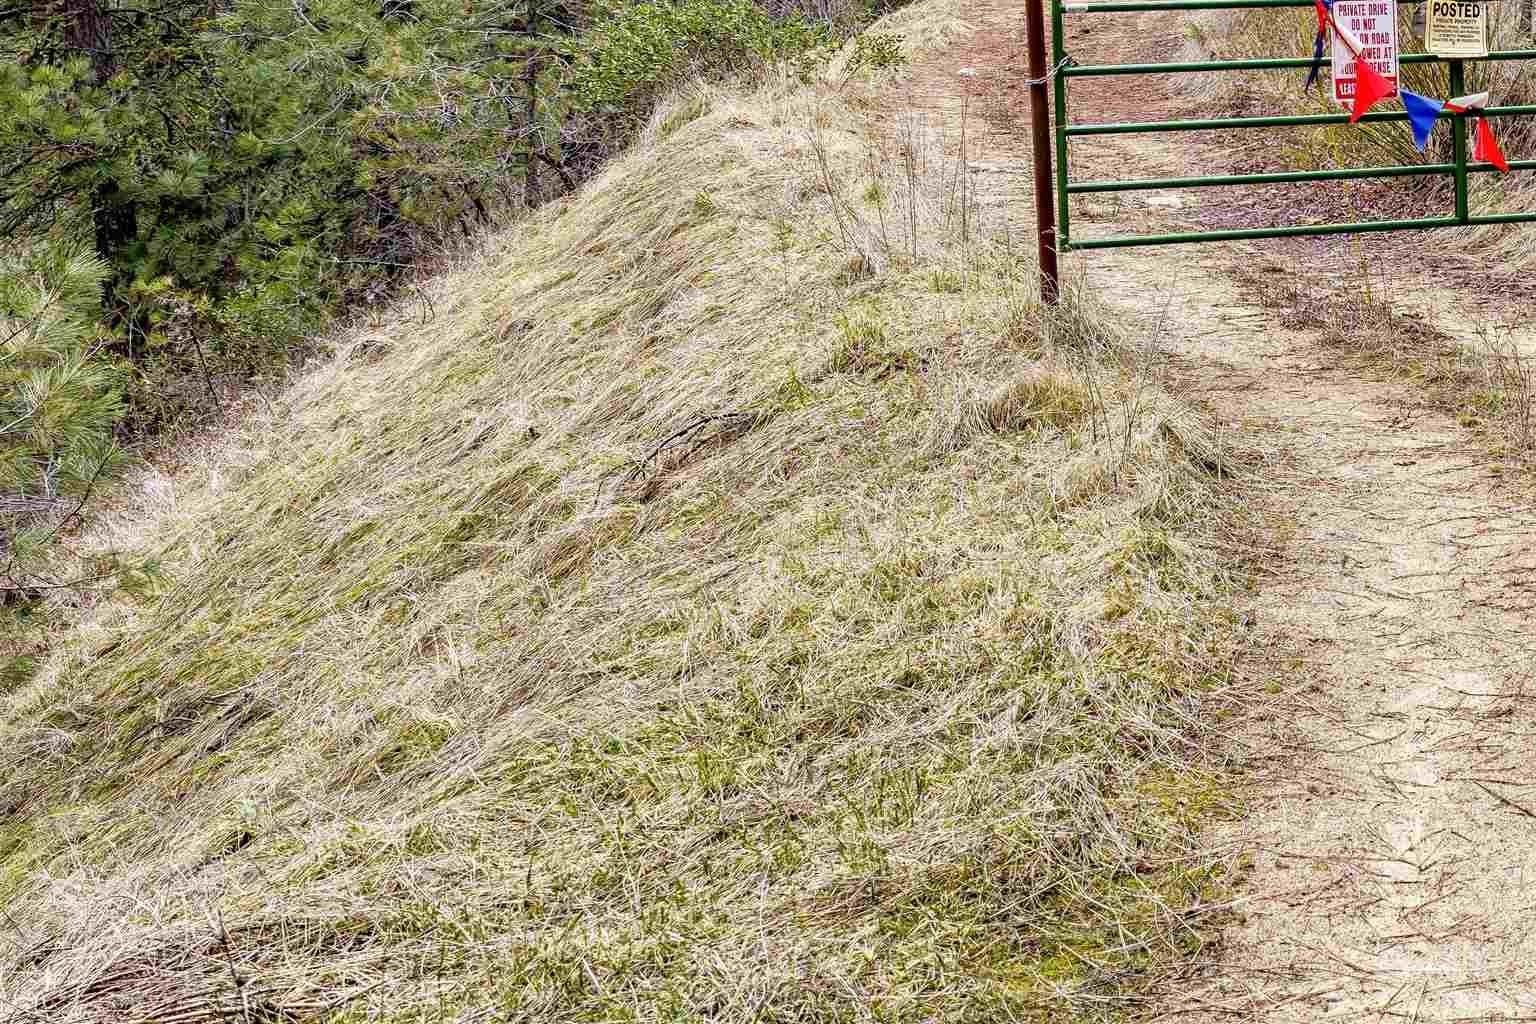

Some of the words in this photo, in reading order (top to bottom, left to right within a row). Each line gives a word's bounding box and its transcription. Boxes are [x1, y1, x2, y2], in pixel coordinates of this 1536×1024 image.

[1338, 4, 1366, 17] PRIVATE
[1369, 3, 1388, 16] DRIVE
[1433, 2, 1480, 17] POSTED
[1351, 18, 1360, 30] DO
[1363, 18, 1376, 30] NOT
[1359, 33, 1369, 45] ON
[1372, 32, 1390, 44] ROAD
[1361, 47, 1381, 60] OWED
[1384, 46, 1392, 59] AT
